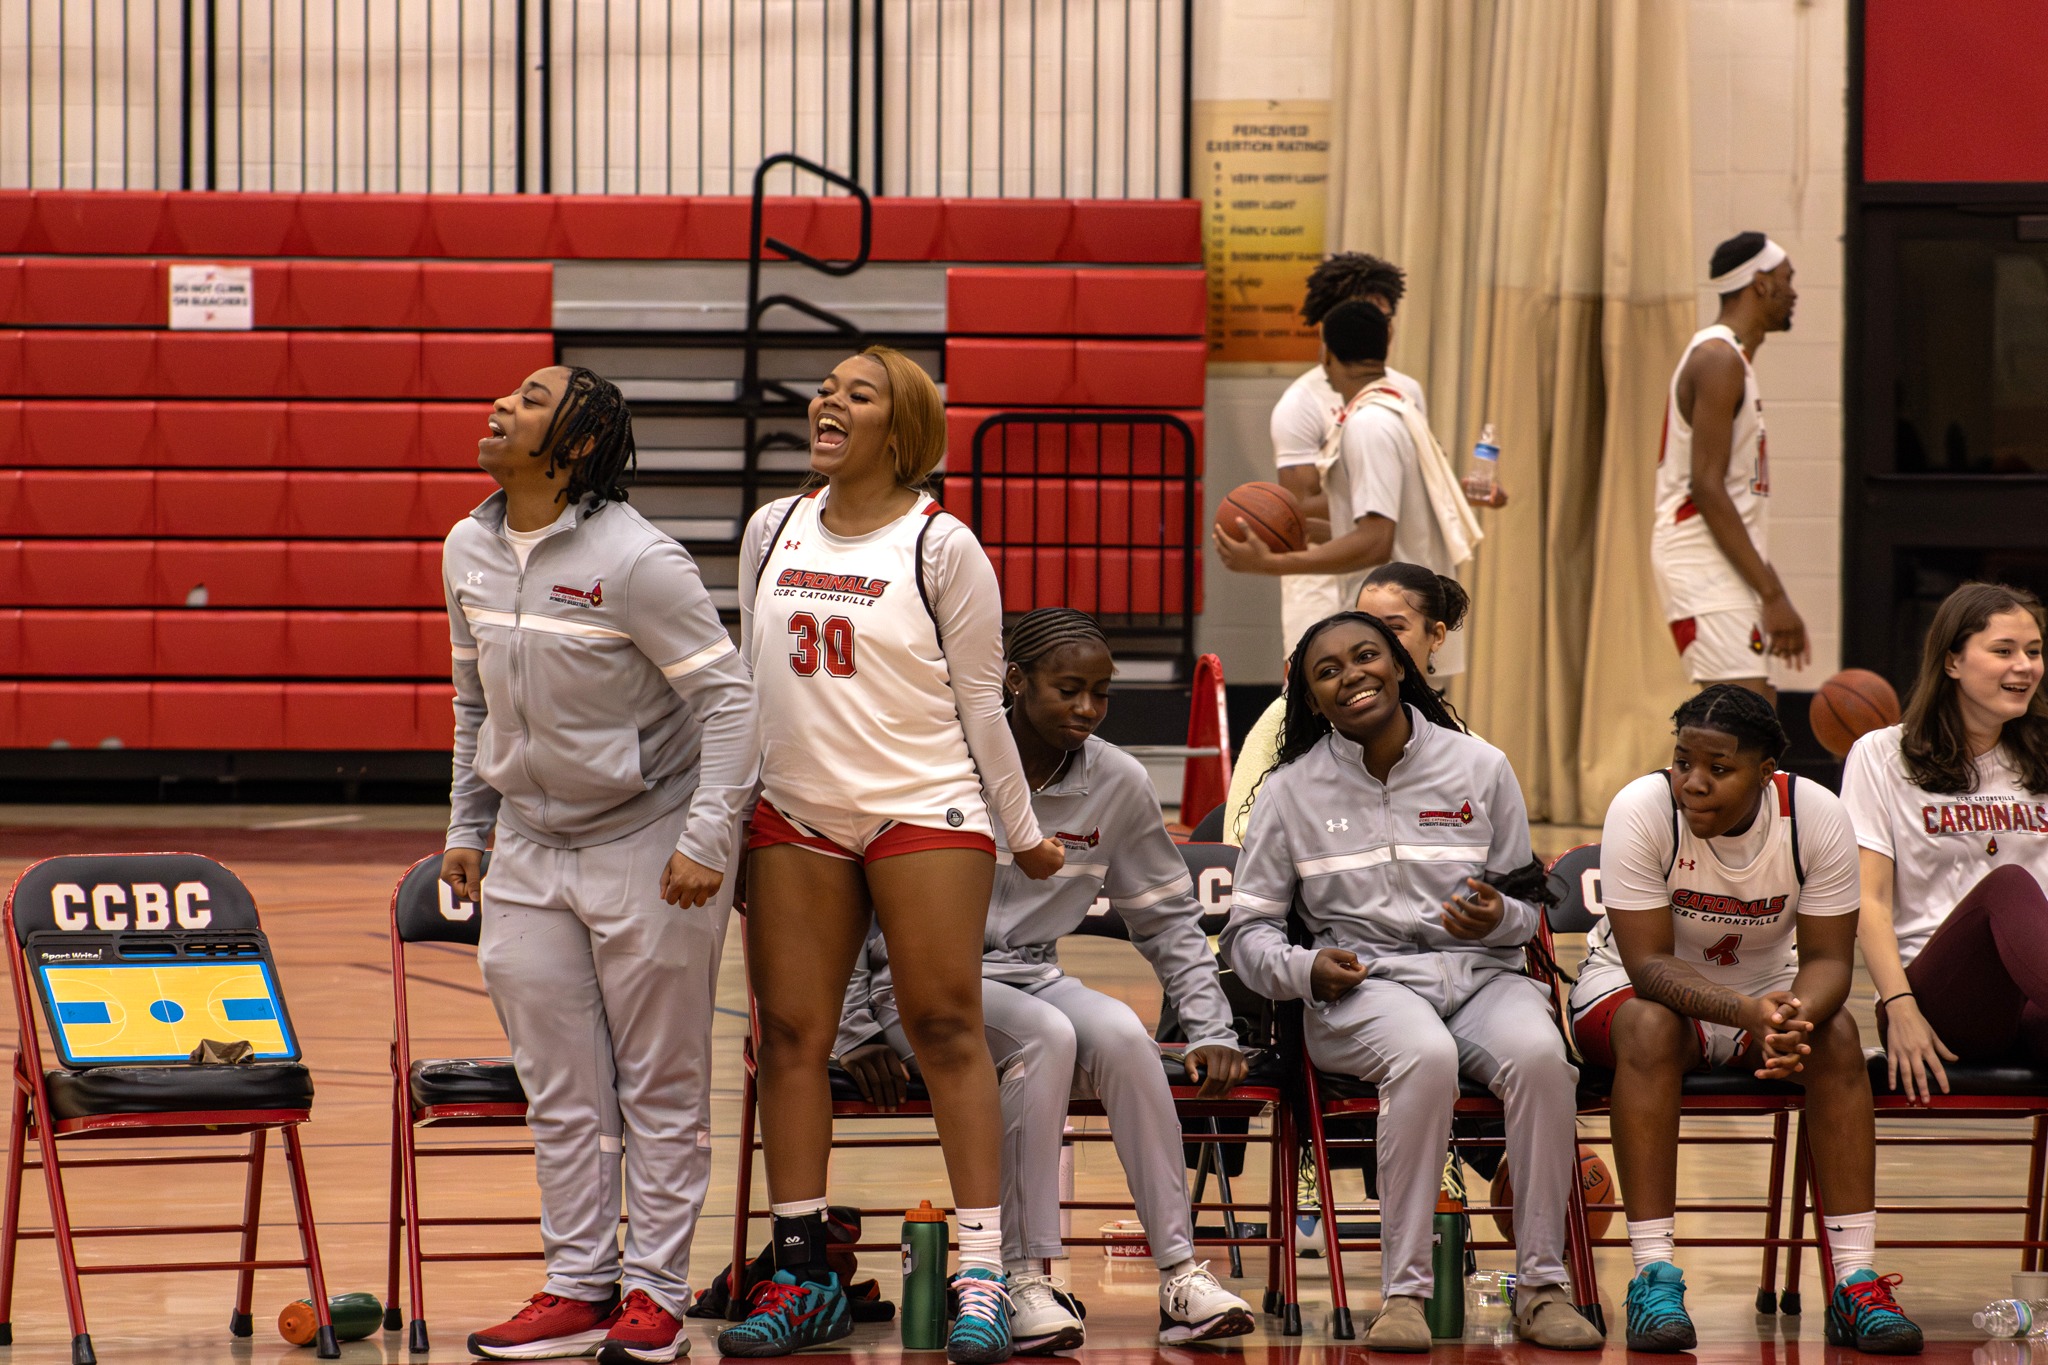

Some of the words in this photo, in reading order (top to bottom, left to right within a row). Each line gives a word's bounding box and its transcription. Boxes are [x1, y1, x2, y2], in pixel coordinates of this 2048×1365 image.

[1206, 141, 1273, 152] EXERTION
[1277, 141, 1331, 152] RATING
[776, 568, 892, 598] CARDINALS
[773, 588, 797, 597] CCBC
[799, 590, 876, 608] CATONSVILLE
[787, 610, 858, 679] 30
[1922, 804, 2048, 834] CARDINALS
[52, 881, 212, 930] CCBC
[1672, 889, 1789, 917] CARDINALS
[1701, 914, 1780, 926] CATONSVILLE
[41, 952, 70, 962] Sport
[1703, 933, 1743, 966] 4
